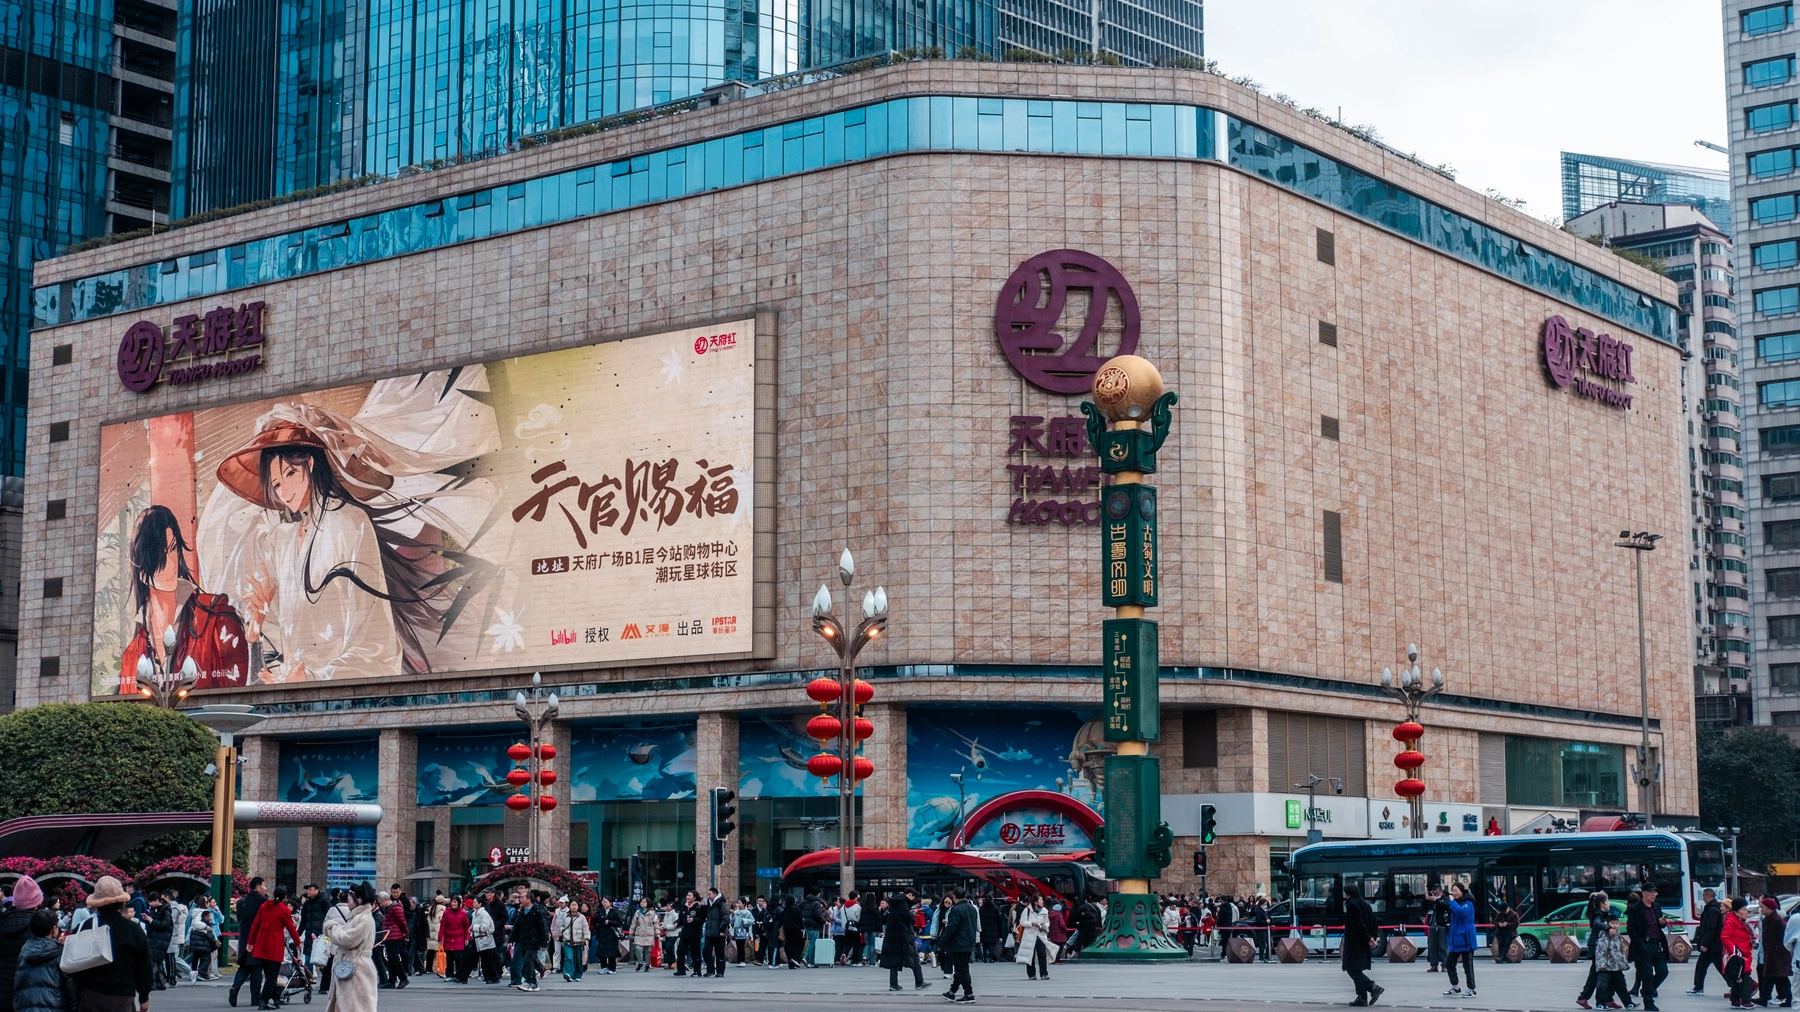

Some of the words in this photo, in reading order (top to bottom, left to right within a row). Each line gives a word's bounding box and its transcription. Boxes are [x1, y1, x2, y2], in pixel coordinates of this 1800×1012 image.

[170, 301, 265, 359] 天府红
[709, 332, 737, 348] 天府红
[1577, 327, 1635, 383] 天府红
[166, 365, 212, 386] TIANFU
[1574, 377, 1605, 399] TIANFU
[1008, 414, 1099, 456] 天府
[1006, 465, 1111, 492] TIANF
[512, 458, 739, 550] 天官赐福
[1008, 498, 1102, 525] HOOO
[535, 558, 566, 574] 地址
[572, 540, 739, 571] 天府广场B1层今站购物中心
[1142, 524, 1154, 597] 古蜀文明
[655, 560, 739, 583] 潮玩星球街区
[645, 623, 670, 634] 艾漫
[677, 619, 703, 637] 出品
[711, 616, 737, 626] IPSTAR
[551, 628, 577, 646] bilibili
[584, 627, 610, 644] 授权
[1023, 823, 1065, 838] 天府红
[505, 848, 530, 856] CHAG
